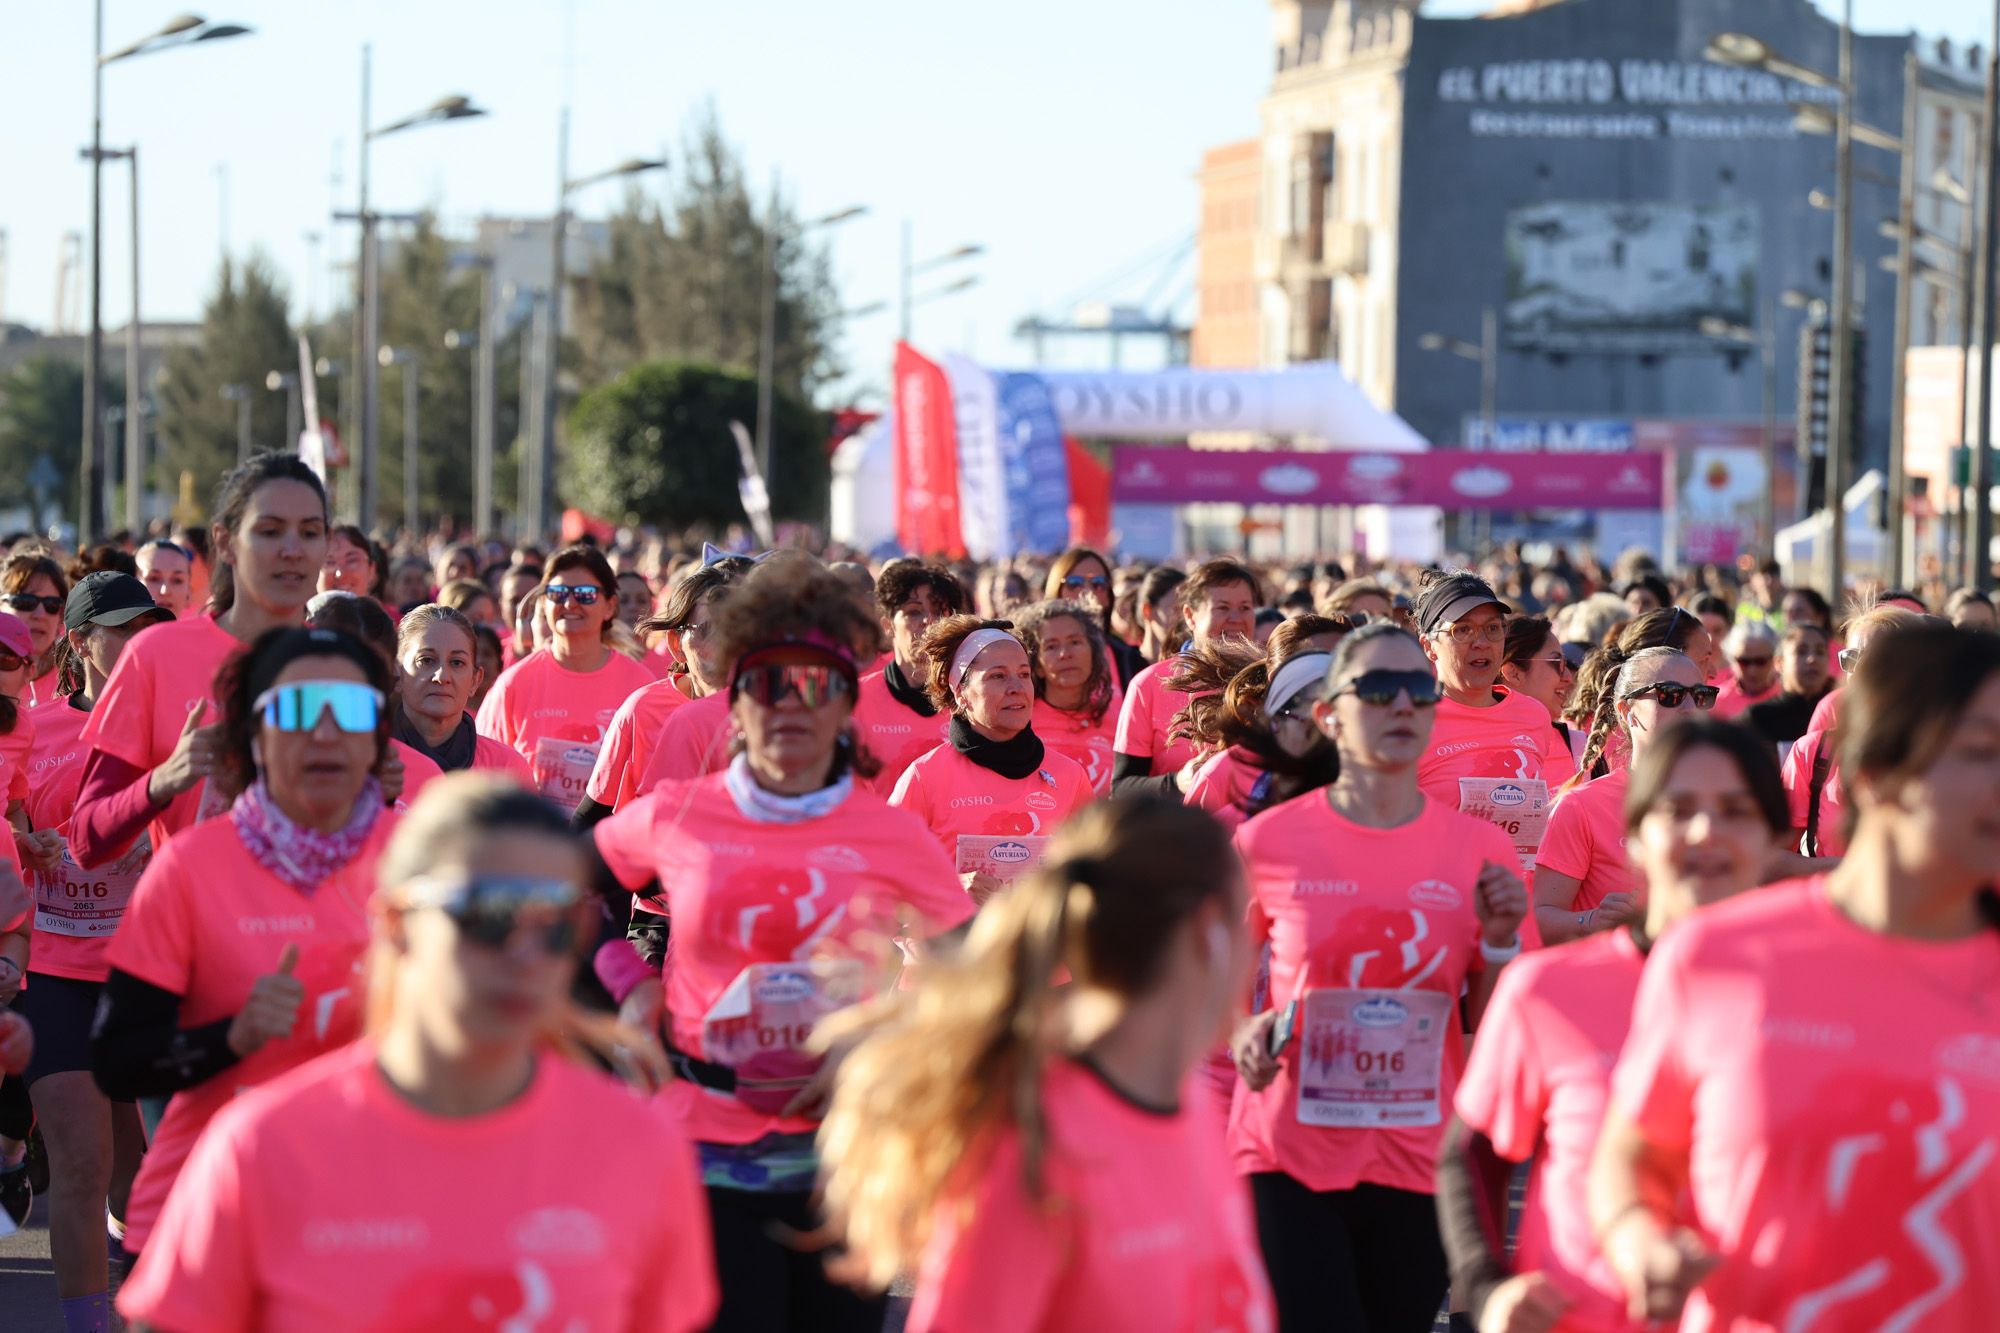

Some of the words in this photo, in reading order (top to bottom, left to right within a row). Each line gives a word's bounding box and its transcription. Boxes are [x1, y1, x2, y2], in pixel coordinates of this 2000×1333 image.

[1482, 59, 1614, 103] PUERTO
[872, 724, 912, 735] OYSHO
[1436, 741, 1480, 757] OYSHO
[35, 752, 76, 772] OYSHO
[951, 796, 993, 808] OYSHO
[1493, 791, 1524, 801] ASTURIANA
[1494, 820, 1521, 835] 16
[992, 849, 1028, 859] ASTURIANA
[65, 881, 108, 898] 016
[73, 902, 95, 910] 2063
[46, 917, 76, 930] OYSHO
[1355, 1051, 1405, 1073] 016
